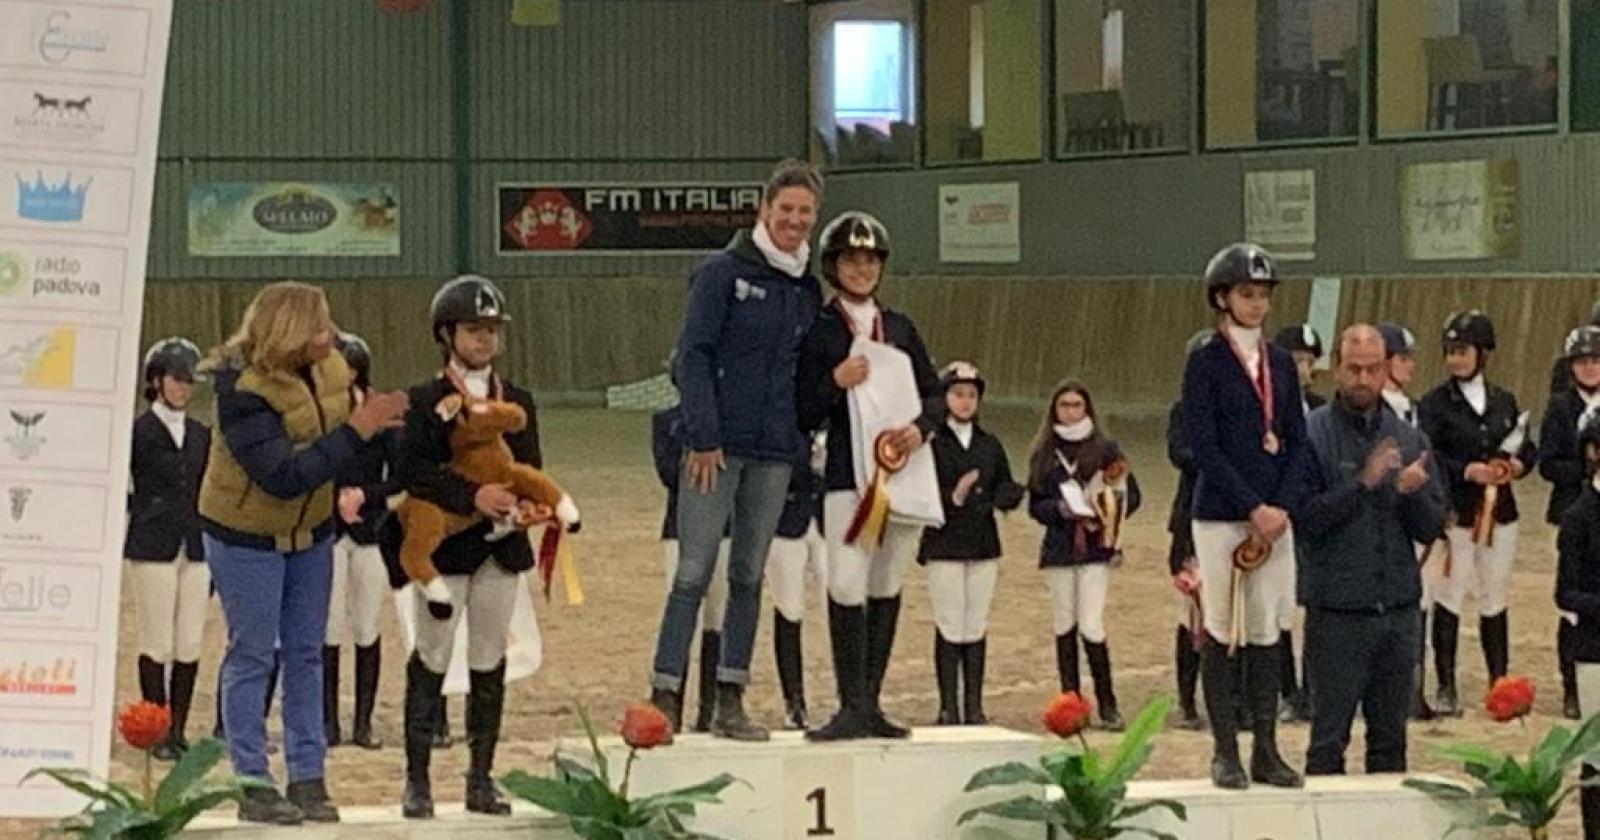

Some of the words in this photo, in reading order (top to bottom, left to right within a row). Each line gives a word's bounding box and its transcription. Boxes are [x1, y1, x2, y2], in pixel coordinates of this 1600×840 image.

[585, 189, 641, 211] FM
[653, 189, 759, 211] ITALIA
[35, 256, 81, 273] radio
[33, 277, 101, 296] padova
[806, 787, 834, 836] 1
